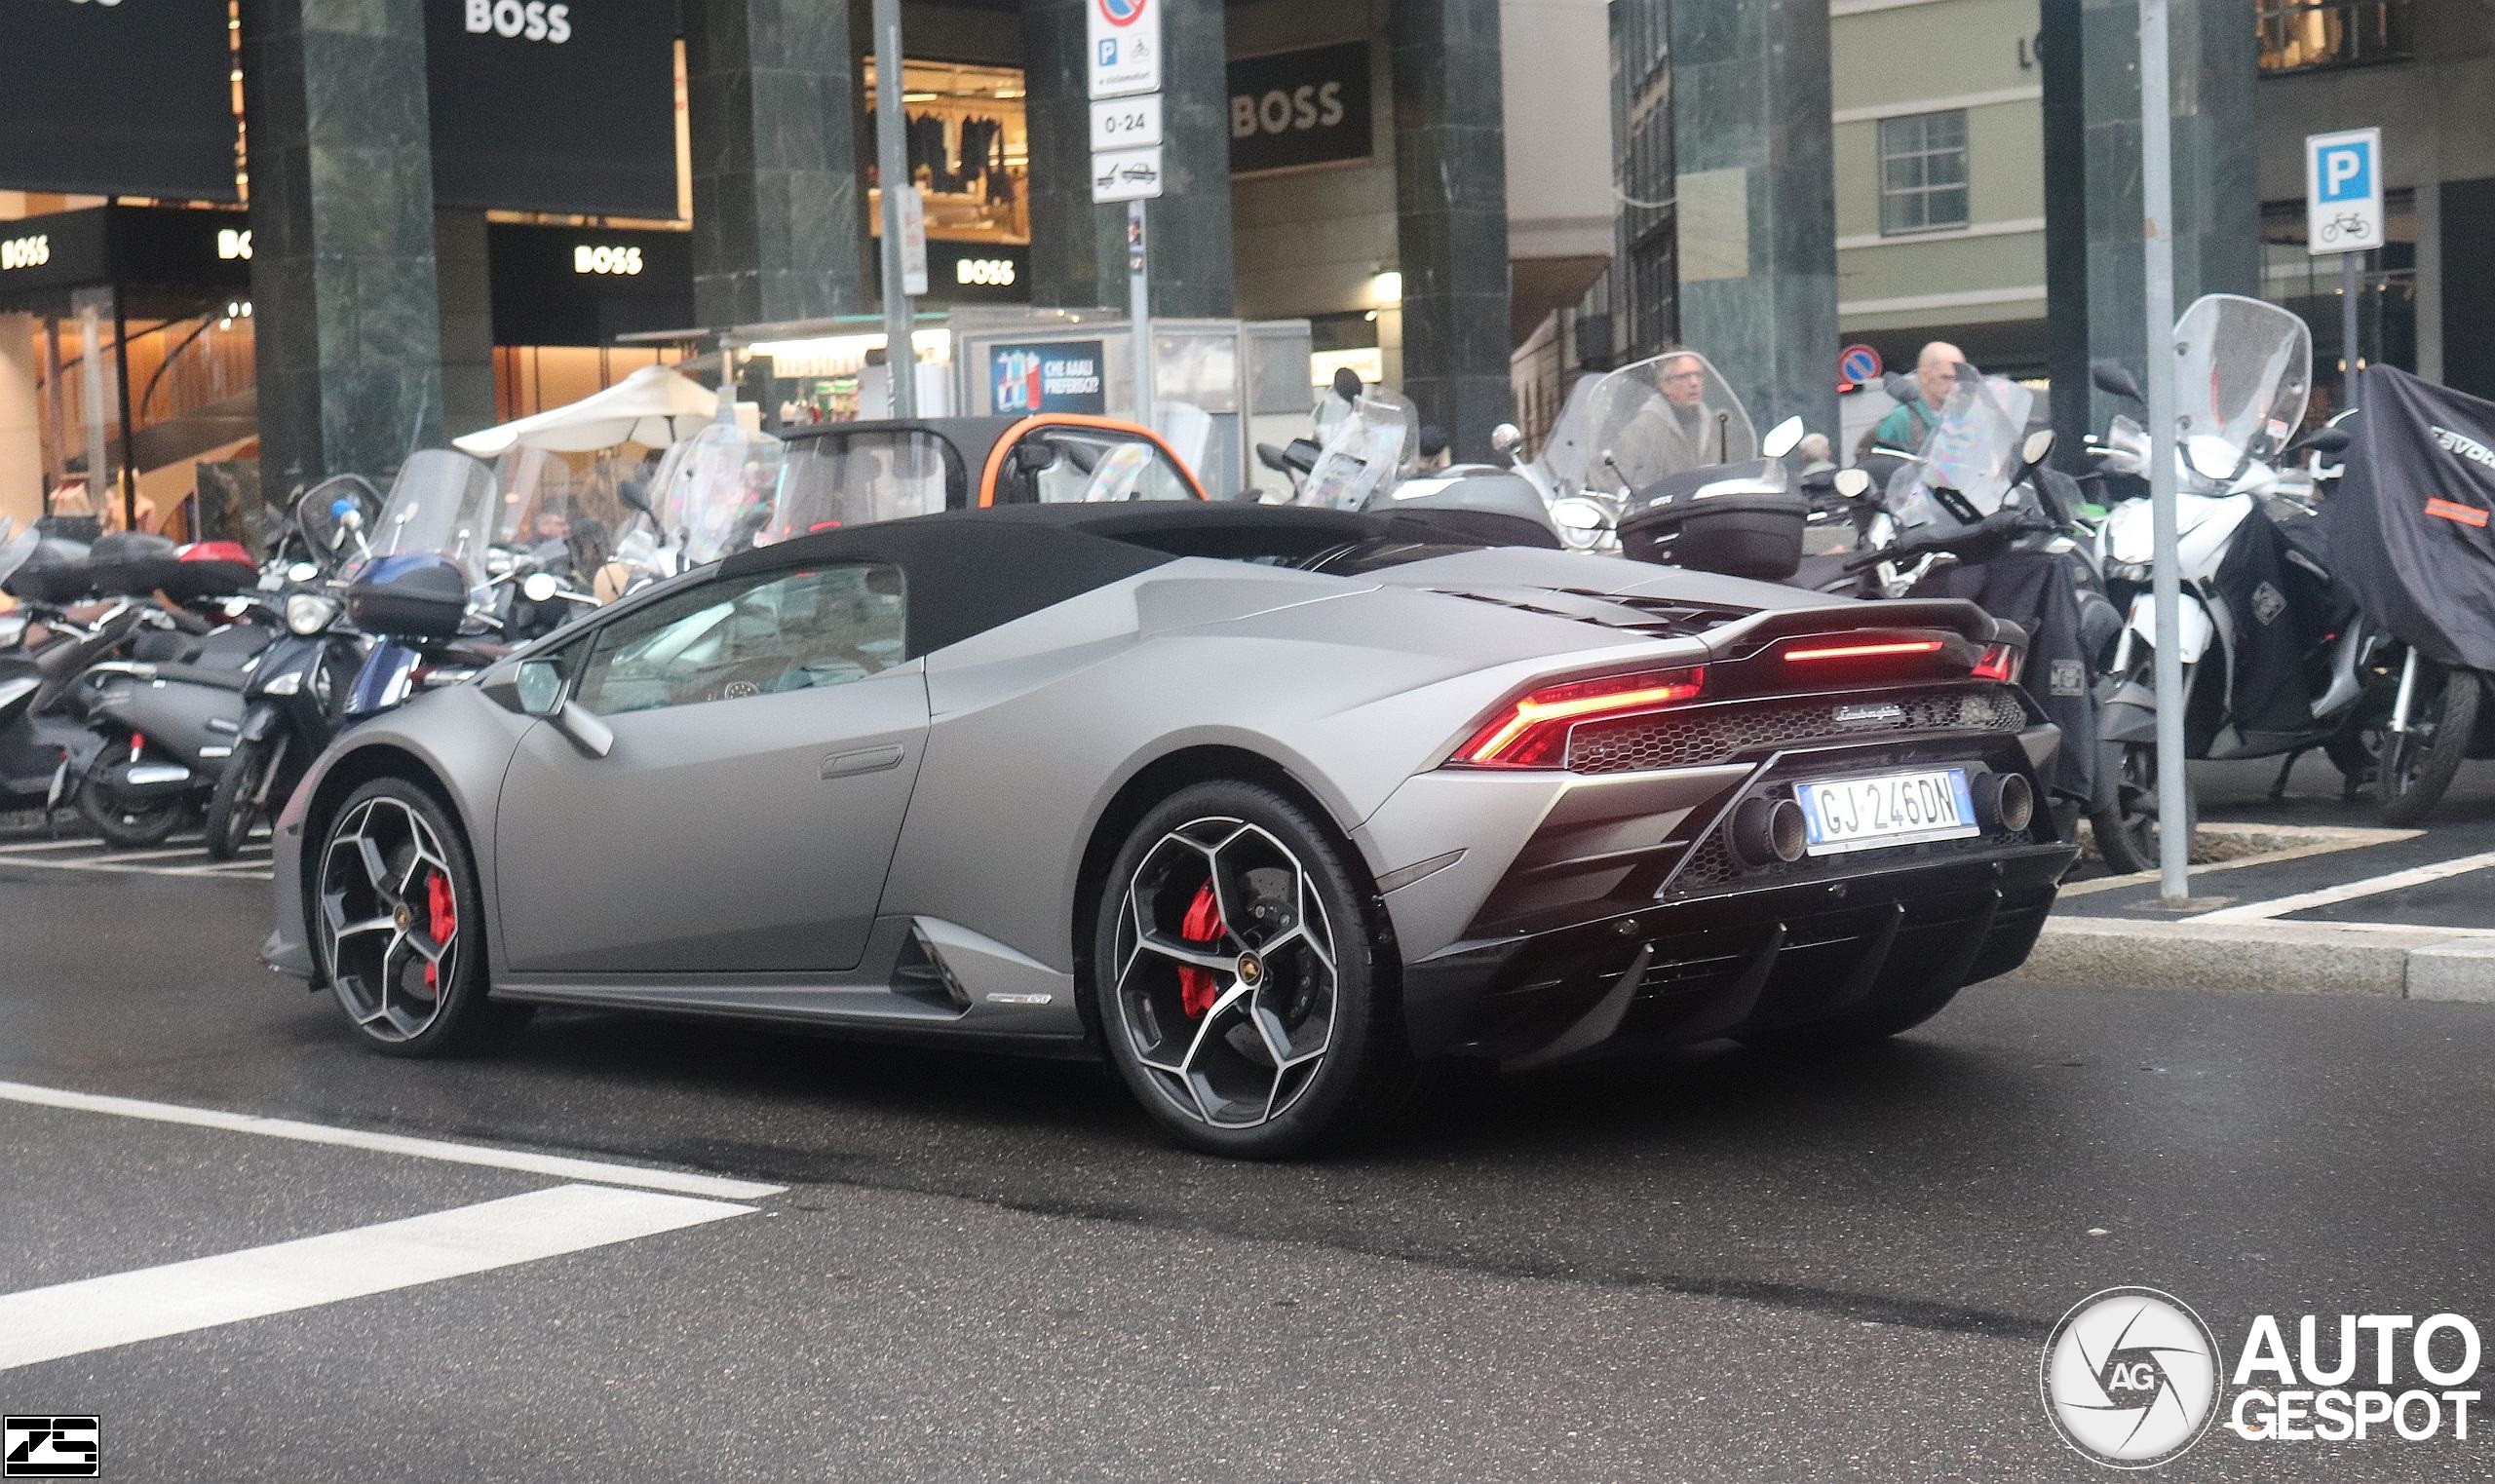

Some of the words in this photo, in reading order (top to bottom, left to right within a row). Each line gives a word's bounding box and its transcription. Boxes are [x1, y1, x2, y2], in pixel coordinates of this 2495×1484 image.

[465, 0, 571, 44] BOSS
[1105, 113, 1145, 133] 0-24
[1230, 81, 1344, 138] BOSS
[2327, 150, 2360, 196] P
[1, 234, 50, 271] BOSS
[574, 245, 644, 276] BOSS
[956, 258, 1016, 286] BOSS
[1821, 786, 1860, 834] GJ
